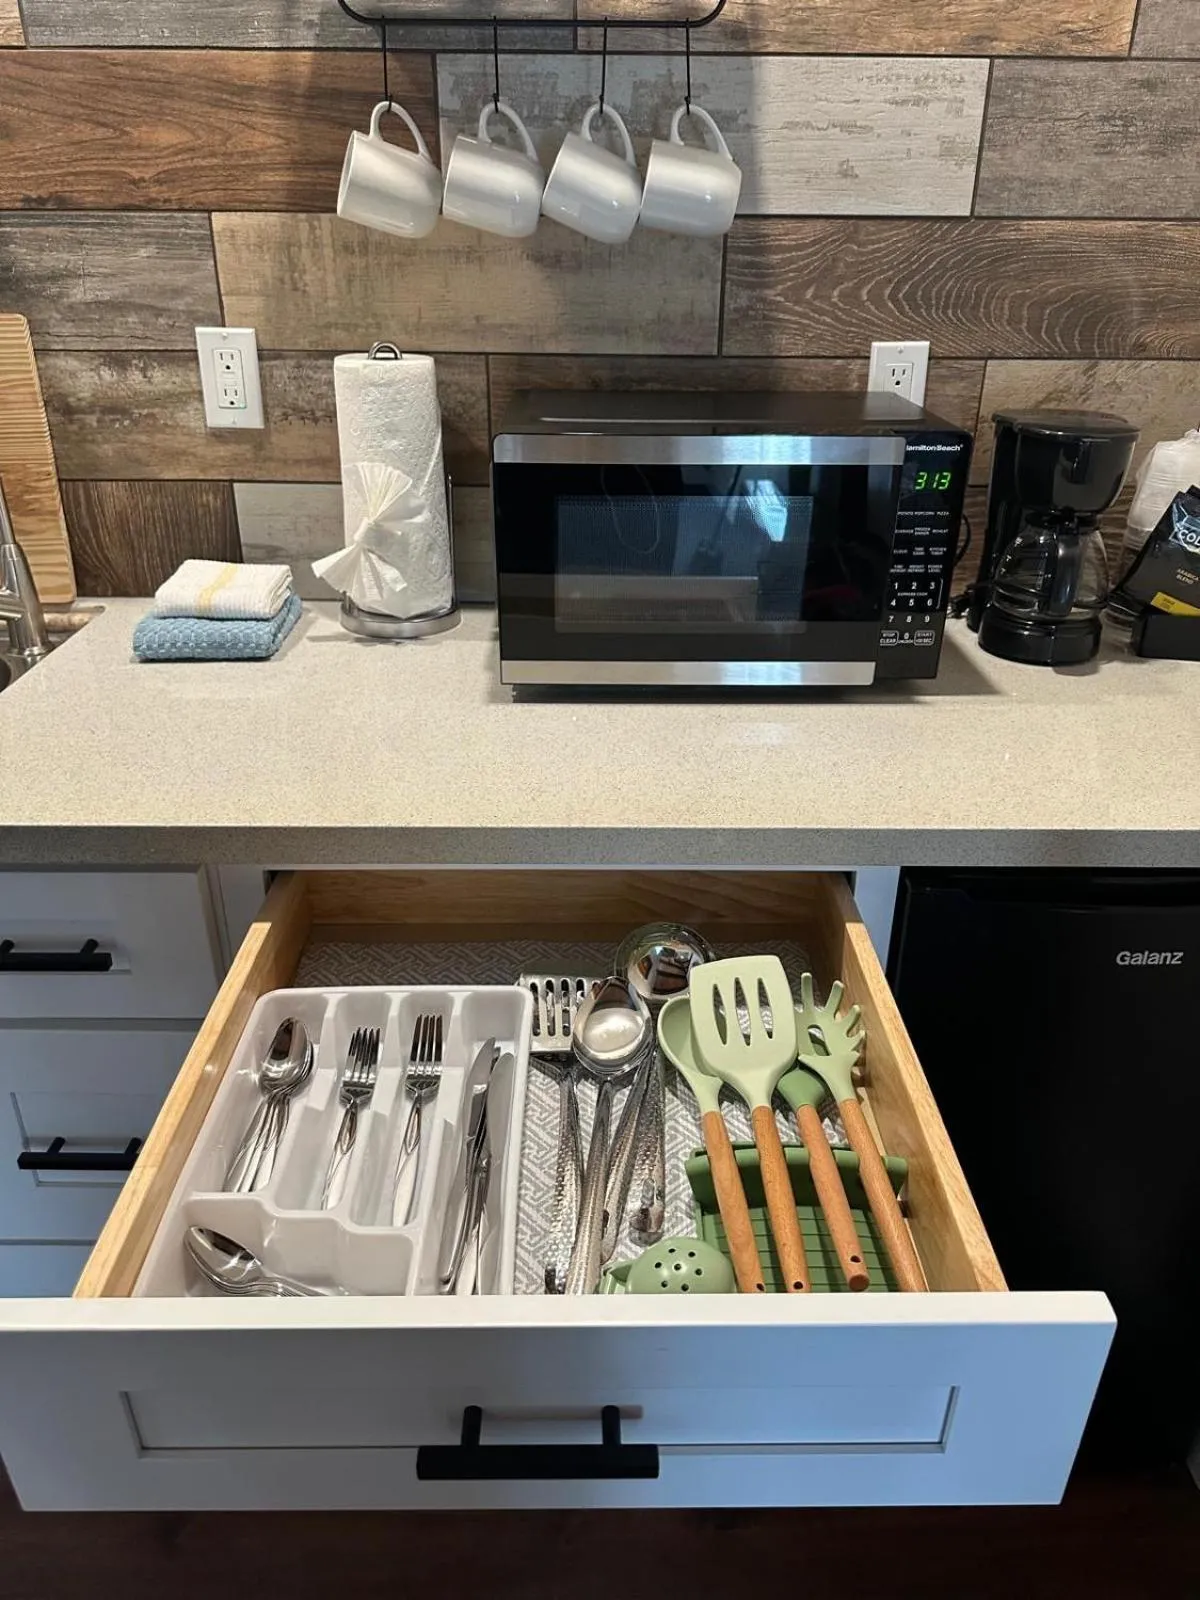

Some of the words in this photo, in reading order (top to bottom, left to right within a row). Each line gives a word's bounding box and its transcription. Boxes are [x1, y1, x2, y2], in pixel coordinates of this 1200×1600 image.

[915, 472, 951, 490] 313
[894, 581, 899, 590] 1
[911, 581, 917, 590] 2
[929, 581, 936, 590] 3
[890, 598, 897, 607] 4
[908, 598, 915, 607] 5
[927, 598, 933, 607] 6
[888, 615, 895, 623] 7
[906, 615, 912, 623] 8
[924, 614, 930, 623] 9
[1116, 950, 1184, 965] Galanz
